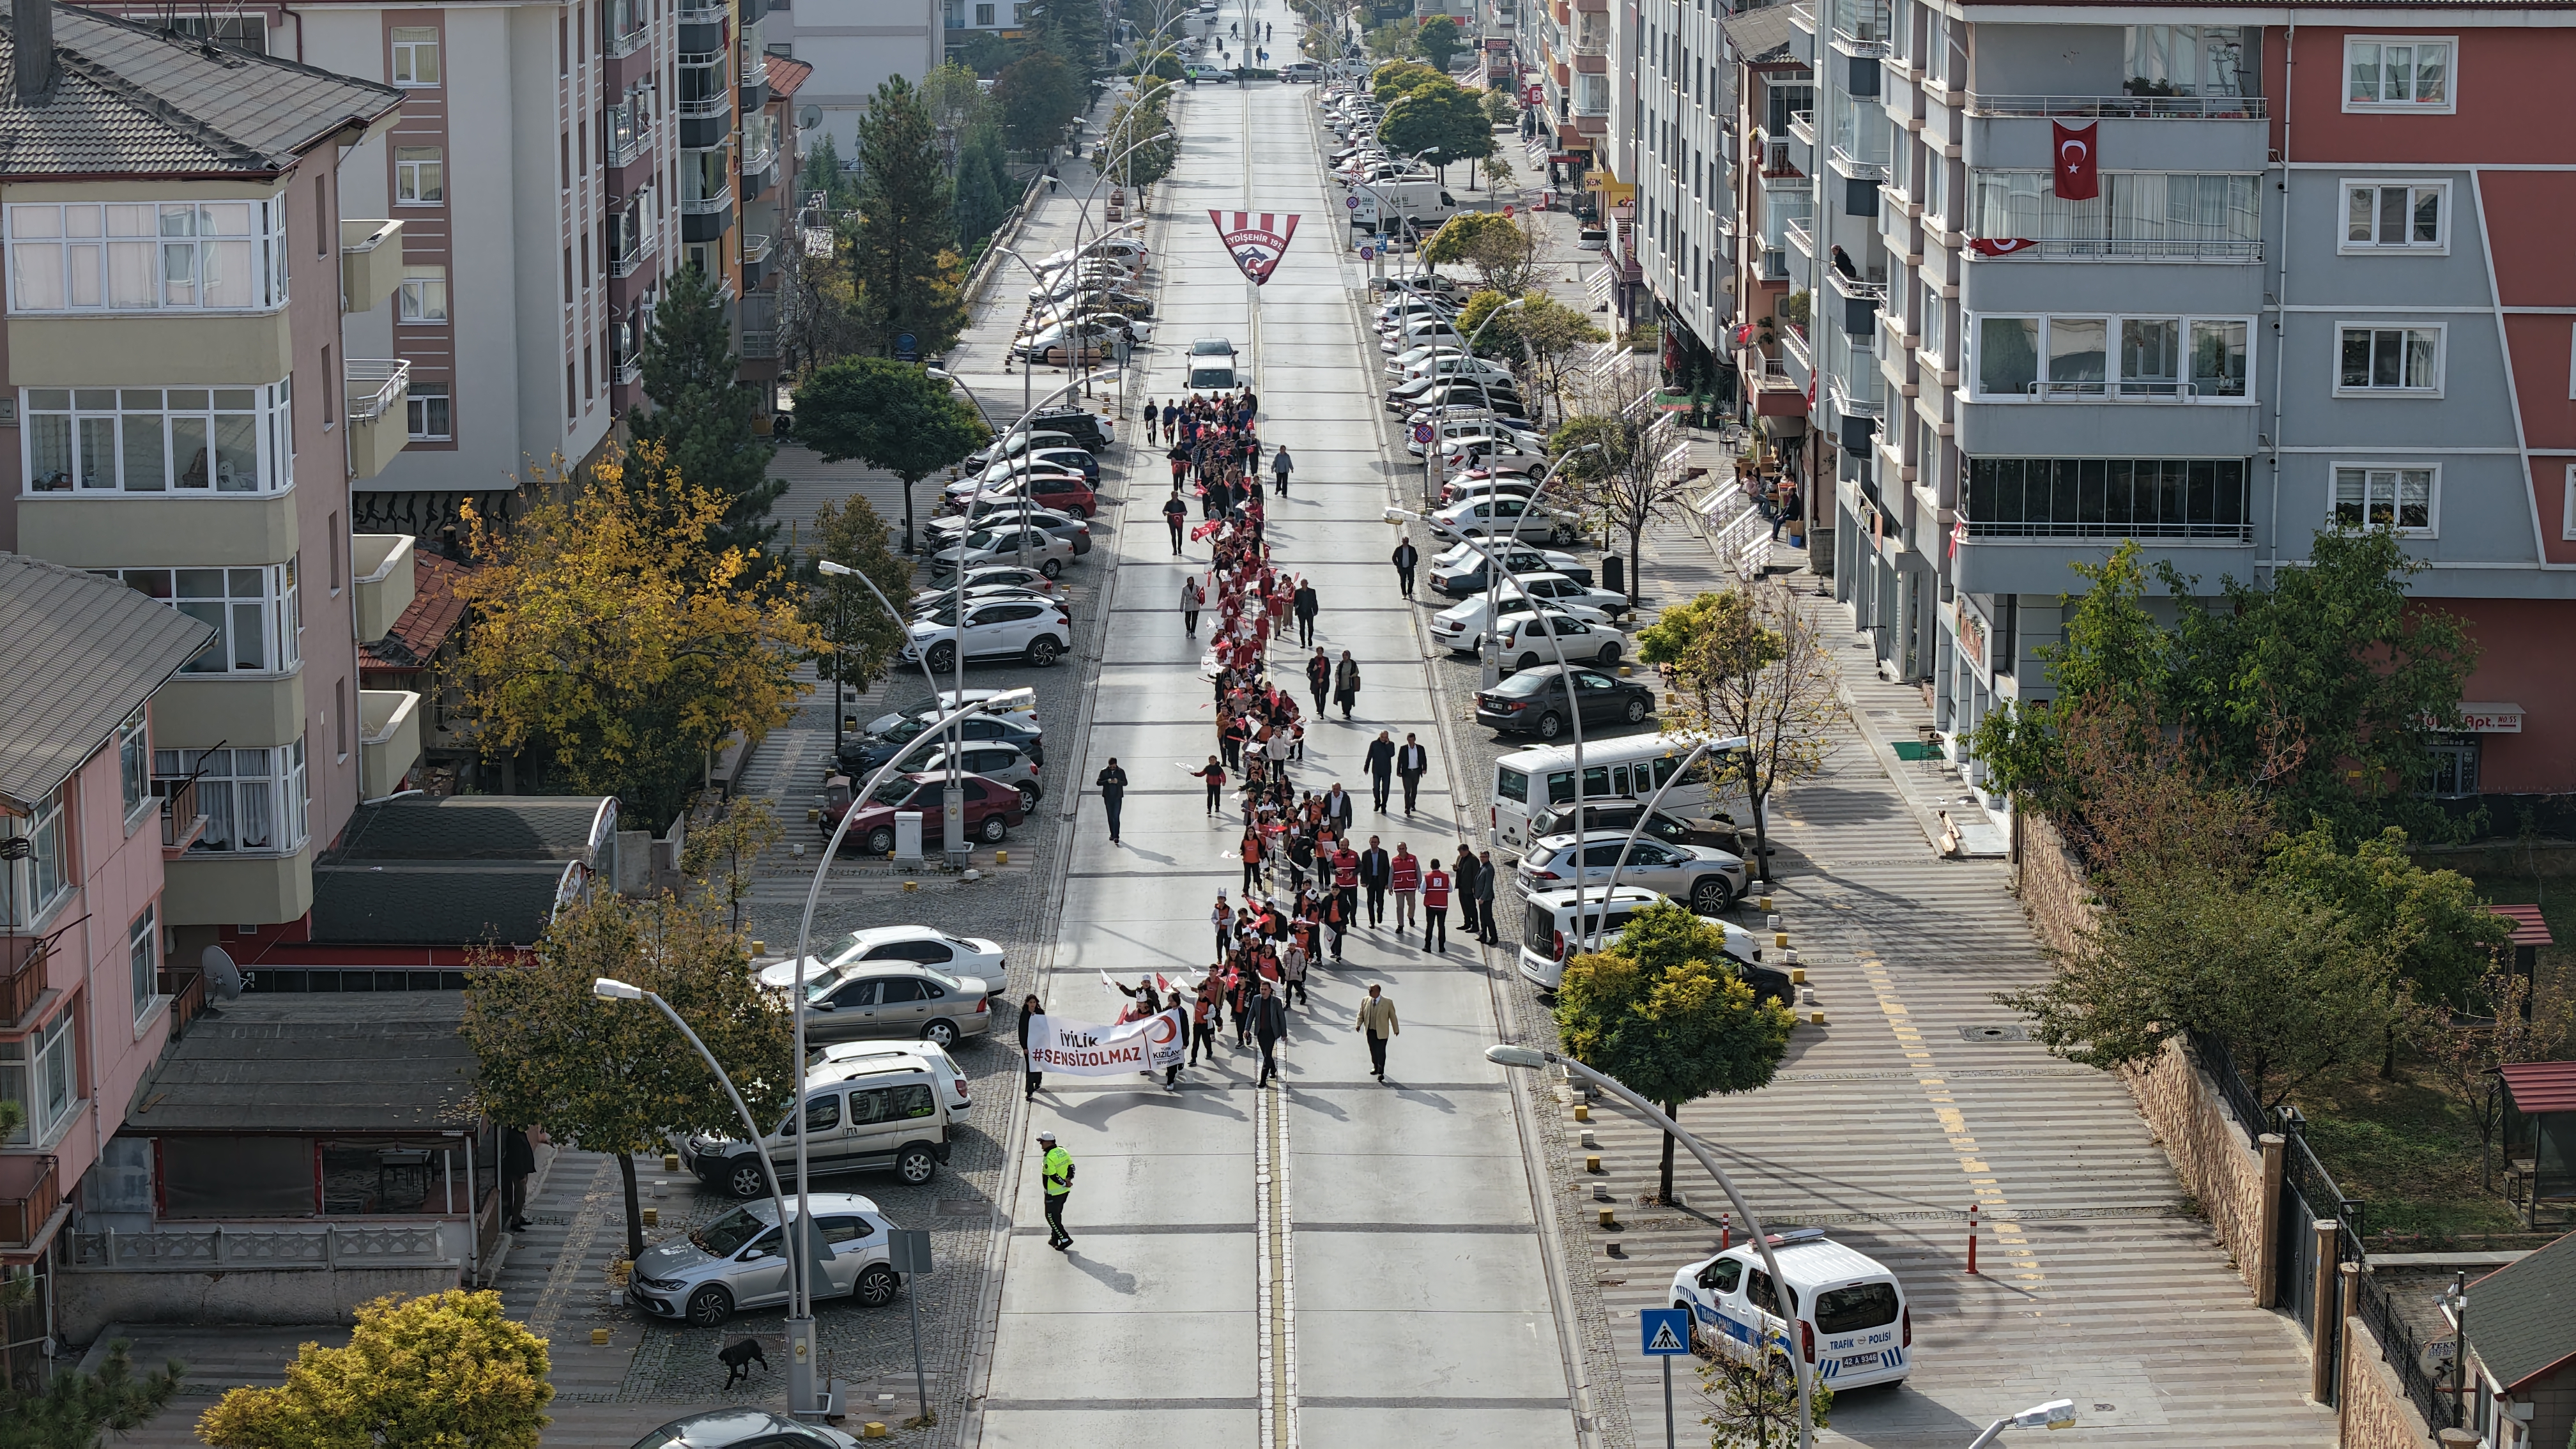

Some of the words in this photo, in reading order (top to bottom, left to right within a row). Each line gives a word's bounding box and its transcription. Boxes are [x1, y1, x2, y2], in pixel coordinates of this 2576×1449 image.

[1531, 89, 1542, 102] B
[1225, 233, 1268, 245] EYDİŞEHİR
[2464, 715, 2495, 730] Apt.
[1060, 1029, 1099, 1048] İYİLİK
[1032, 1046, 1141, 1067] #SENSİZOLMAZ
[1153, 1049, 1180, 1059] KIZILAY
[1830, 1338, 1855, 1350] TRAFİK
[1869, 1330, 1891, 1344] POLİSİ
[2430, 1341, 2457, 1349] TEKN
[1861, 1354, 1877, 1363] 9346
